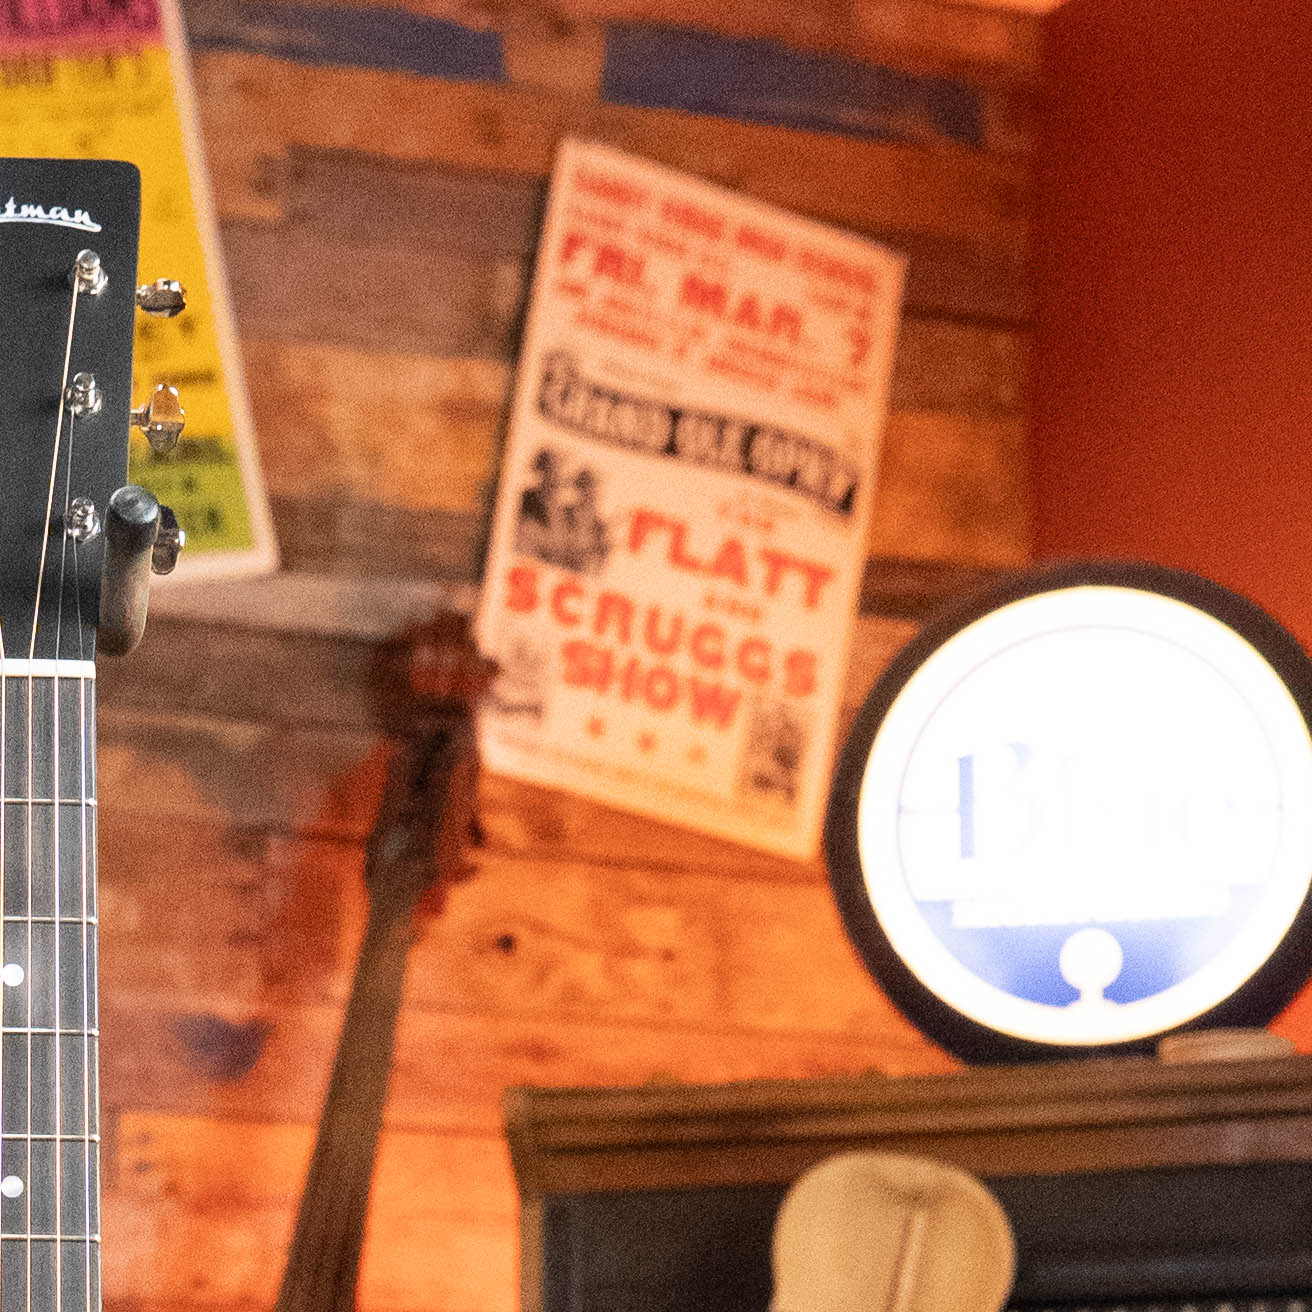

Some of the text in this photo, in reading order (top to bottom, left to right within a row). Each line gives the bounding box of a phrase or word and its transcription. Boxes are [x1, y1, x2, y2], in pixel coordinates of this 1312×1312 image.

[629, 507, 836, 610] FLATT
[505, 563, 819, 698] SCRUGGS
[560, 638, 742, 732] SHOW
